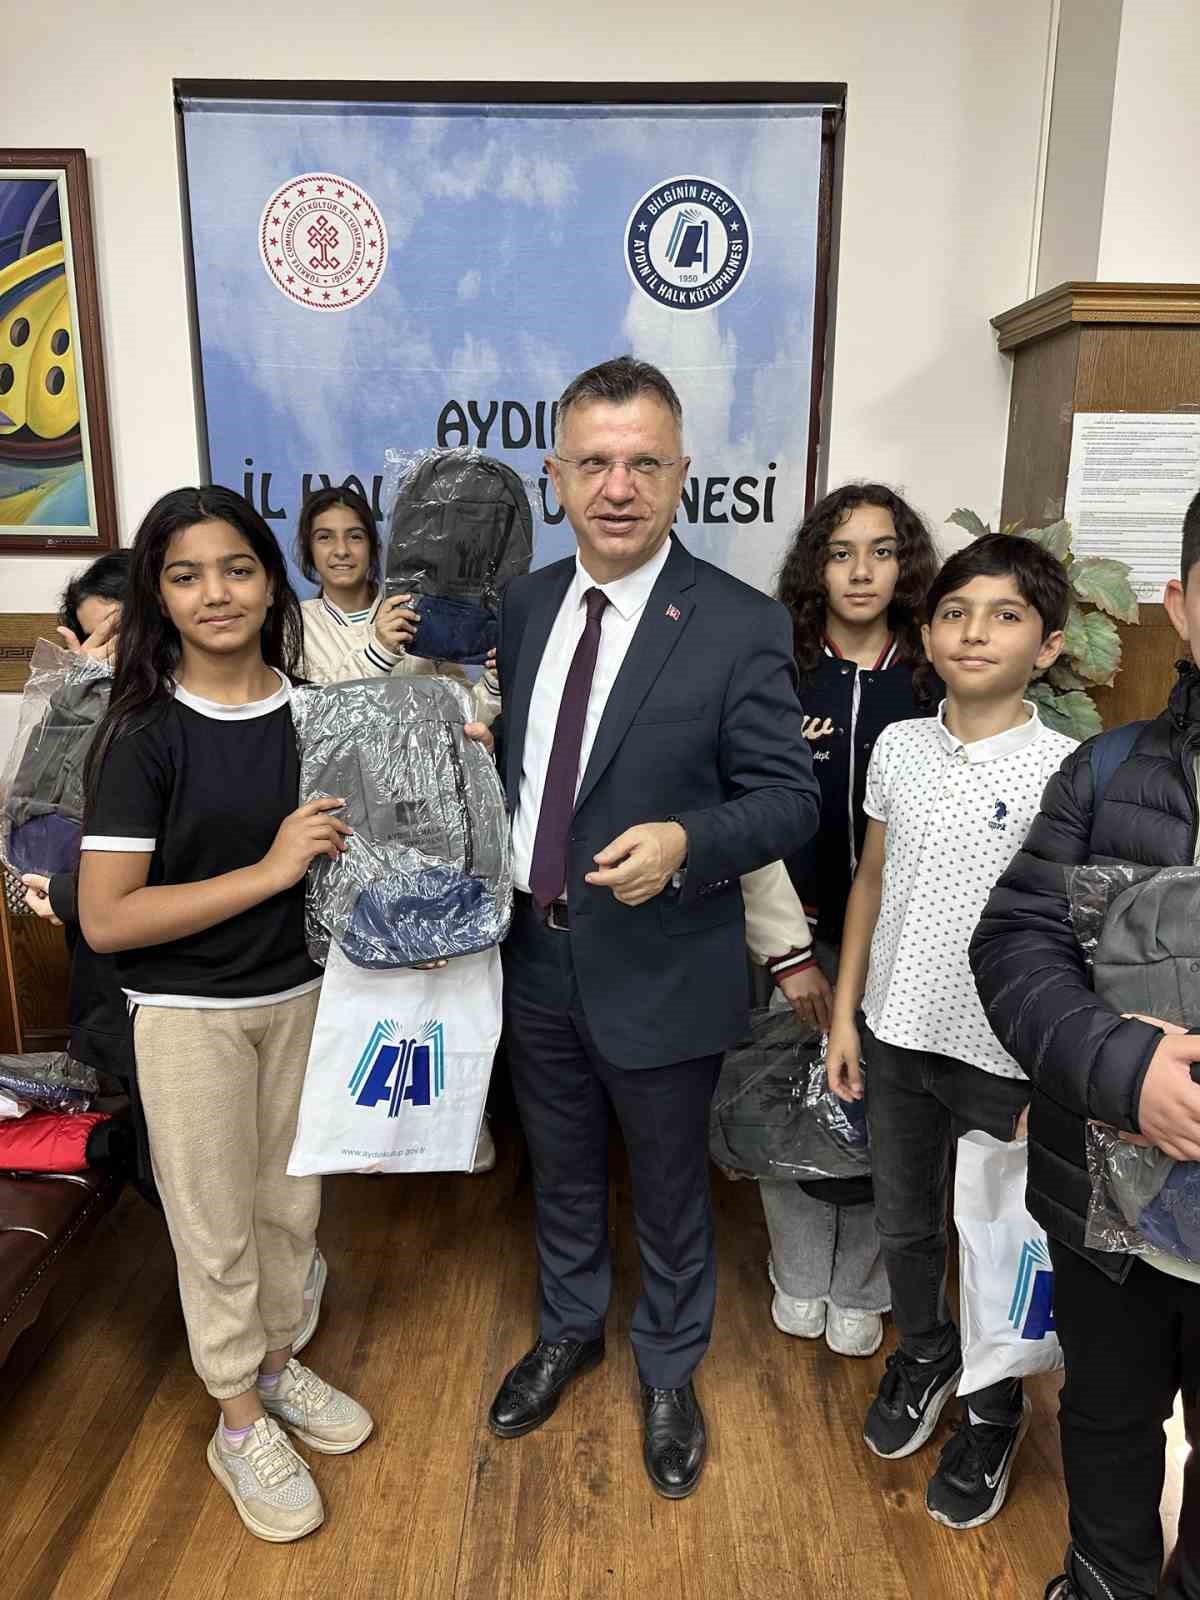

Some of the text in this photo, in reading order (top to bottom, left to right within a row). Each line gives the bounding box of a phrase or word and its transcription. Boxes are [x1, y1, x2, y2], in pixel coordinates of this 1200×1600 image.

[647, 183, 735, 216] BİLGİNİN EFESİ
[285, 205, 308, 258] CUMHURİYETİ
[307, 201, 338, 212] KÜLTÜR
[339, 208, 349, 219] VE
[633, 239, 744, 304] AYDIN İL HALK KÜTÜPHANESİ
[679, 274, 698, 283] 1950
[437, 400, 556, 449] AYDI
[244, 458, 287, 519] İL
